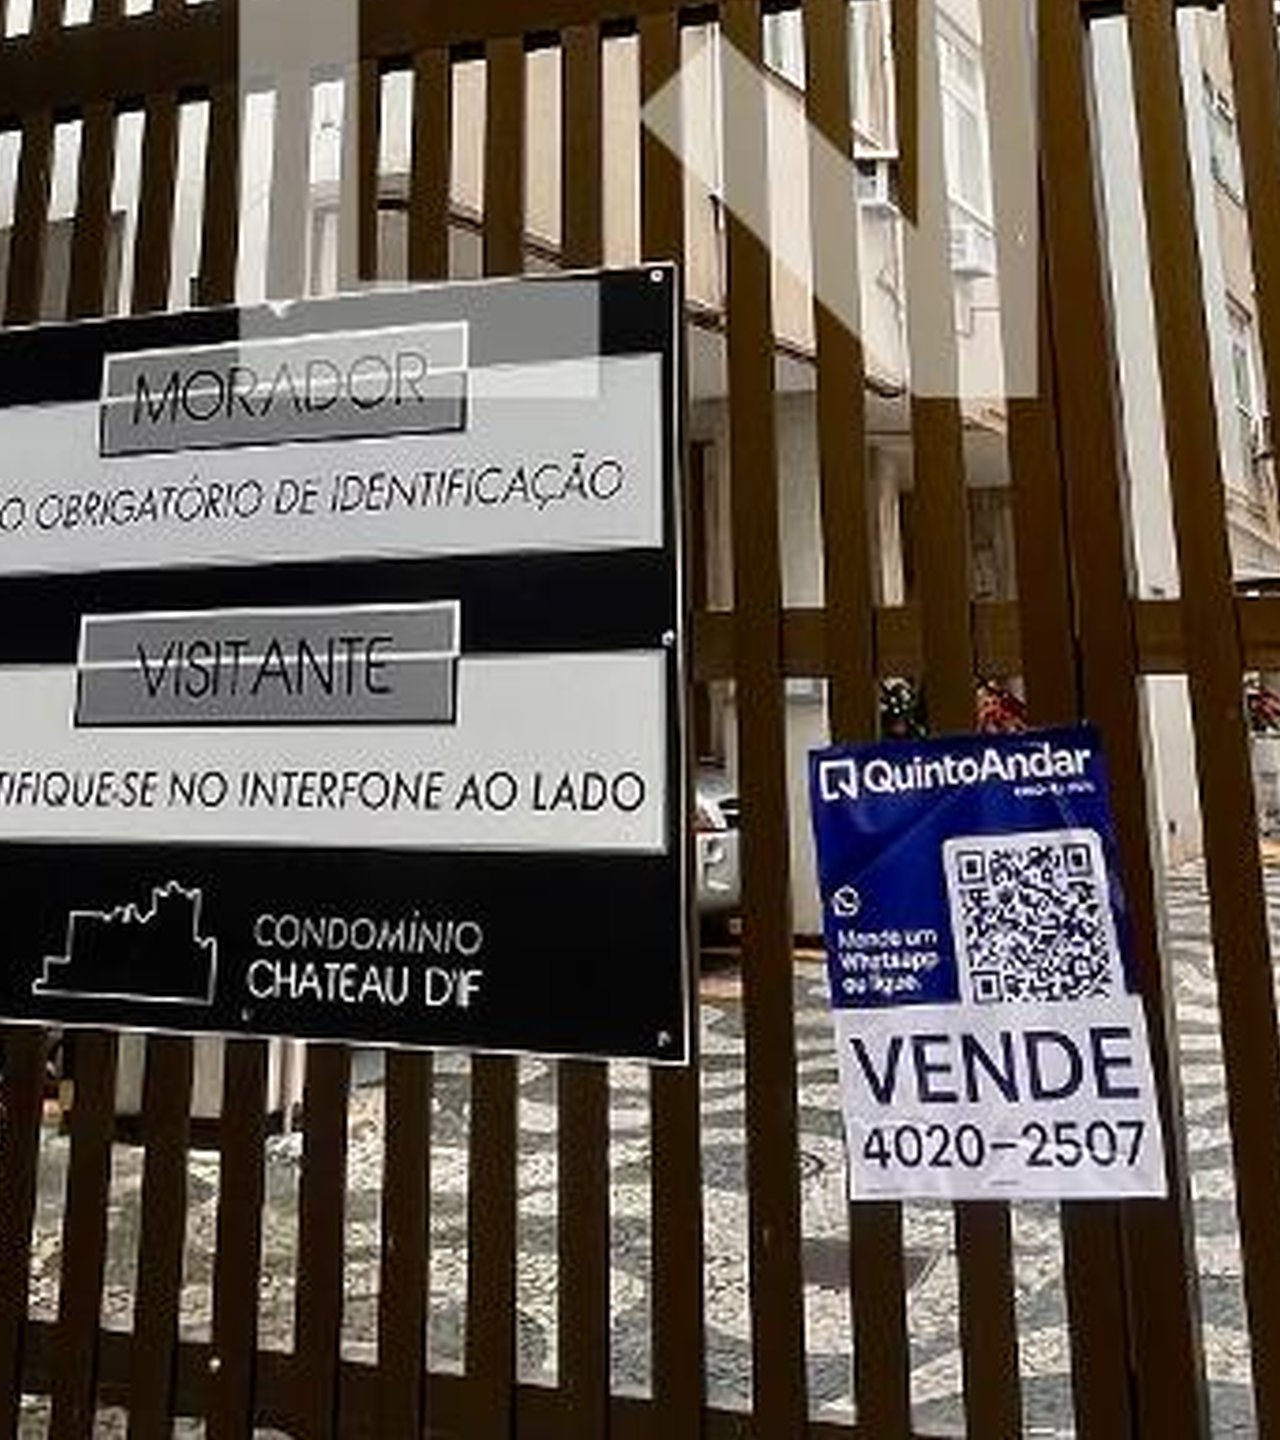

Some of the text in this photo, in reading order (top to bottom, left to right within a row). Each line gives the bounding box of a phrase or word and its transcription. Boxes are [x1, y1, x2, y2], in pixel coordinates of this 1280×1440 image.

[133, 351, 428, 426] MORADOR
[35, 473, 263, 530] OBRIGATÓRIO
[274, 477, 320, 514] DE
[330, 452, 622, 512] IDENTIFICAÇÃO
[136, 636, 394, 698] VISITANTE
[169, 771, 228, 807] NO
[238, 770, 445, 810] INTERFONE
[454, 771, 518, 811] AO
[532, 771, 647, 811] LADO
[863, 742, 1091, 794] QuintoAndar
[254, 910, 483, 954] CONDOMÍNIO
[247, 959, 410, 1005] CHATEAU
[850, 1027, 1140, 1105] VENDE
[863, 1120, 1146, 1168] 4020-2507
